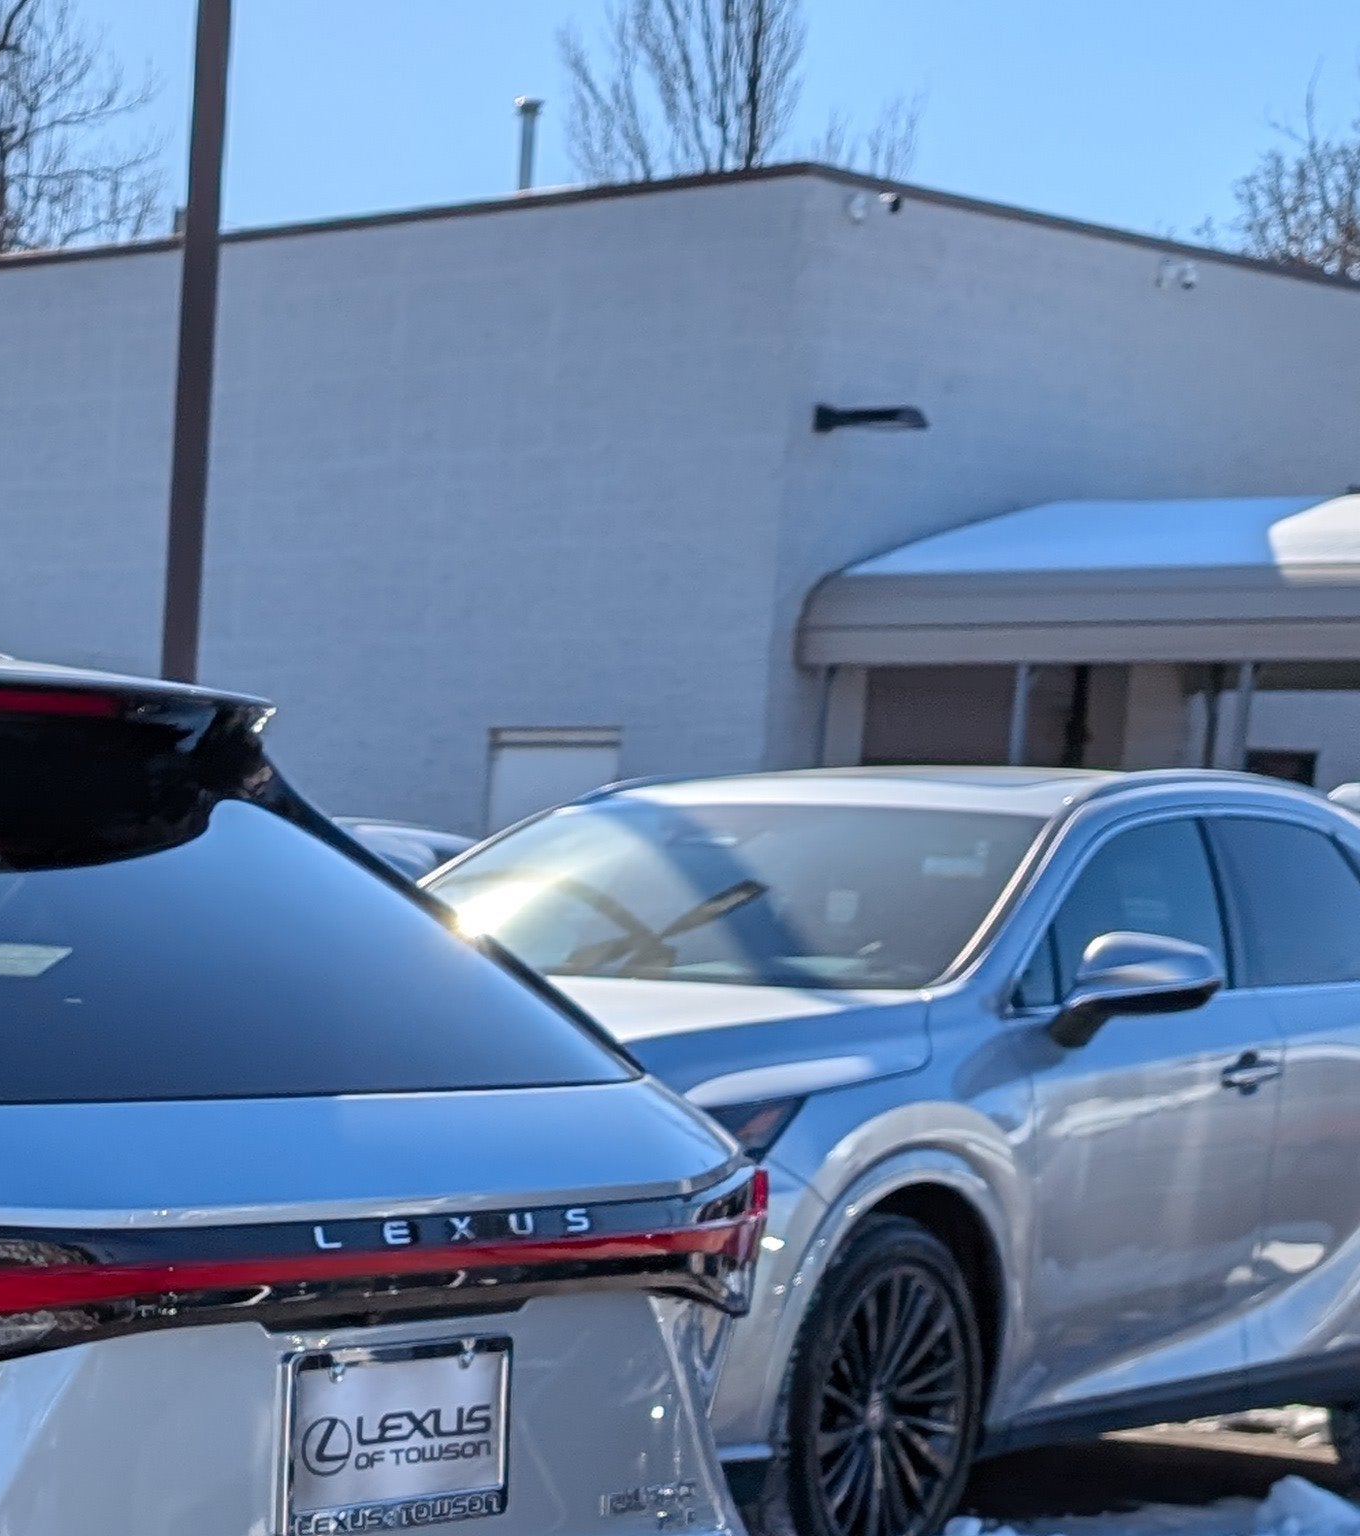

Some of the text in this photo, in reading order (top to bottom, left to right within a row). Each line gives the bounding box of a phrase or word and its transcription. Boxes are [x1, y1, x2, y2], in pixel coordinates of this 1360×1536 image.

[313, 1207, 591, 1250] LEXUS
[355, 1403, 493, 1446] LEXUS
[354, 1439, 492, 1471] OF TOWSON
